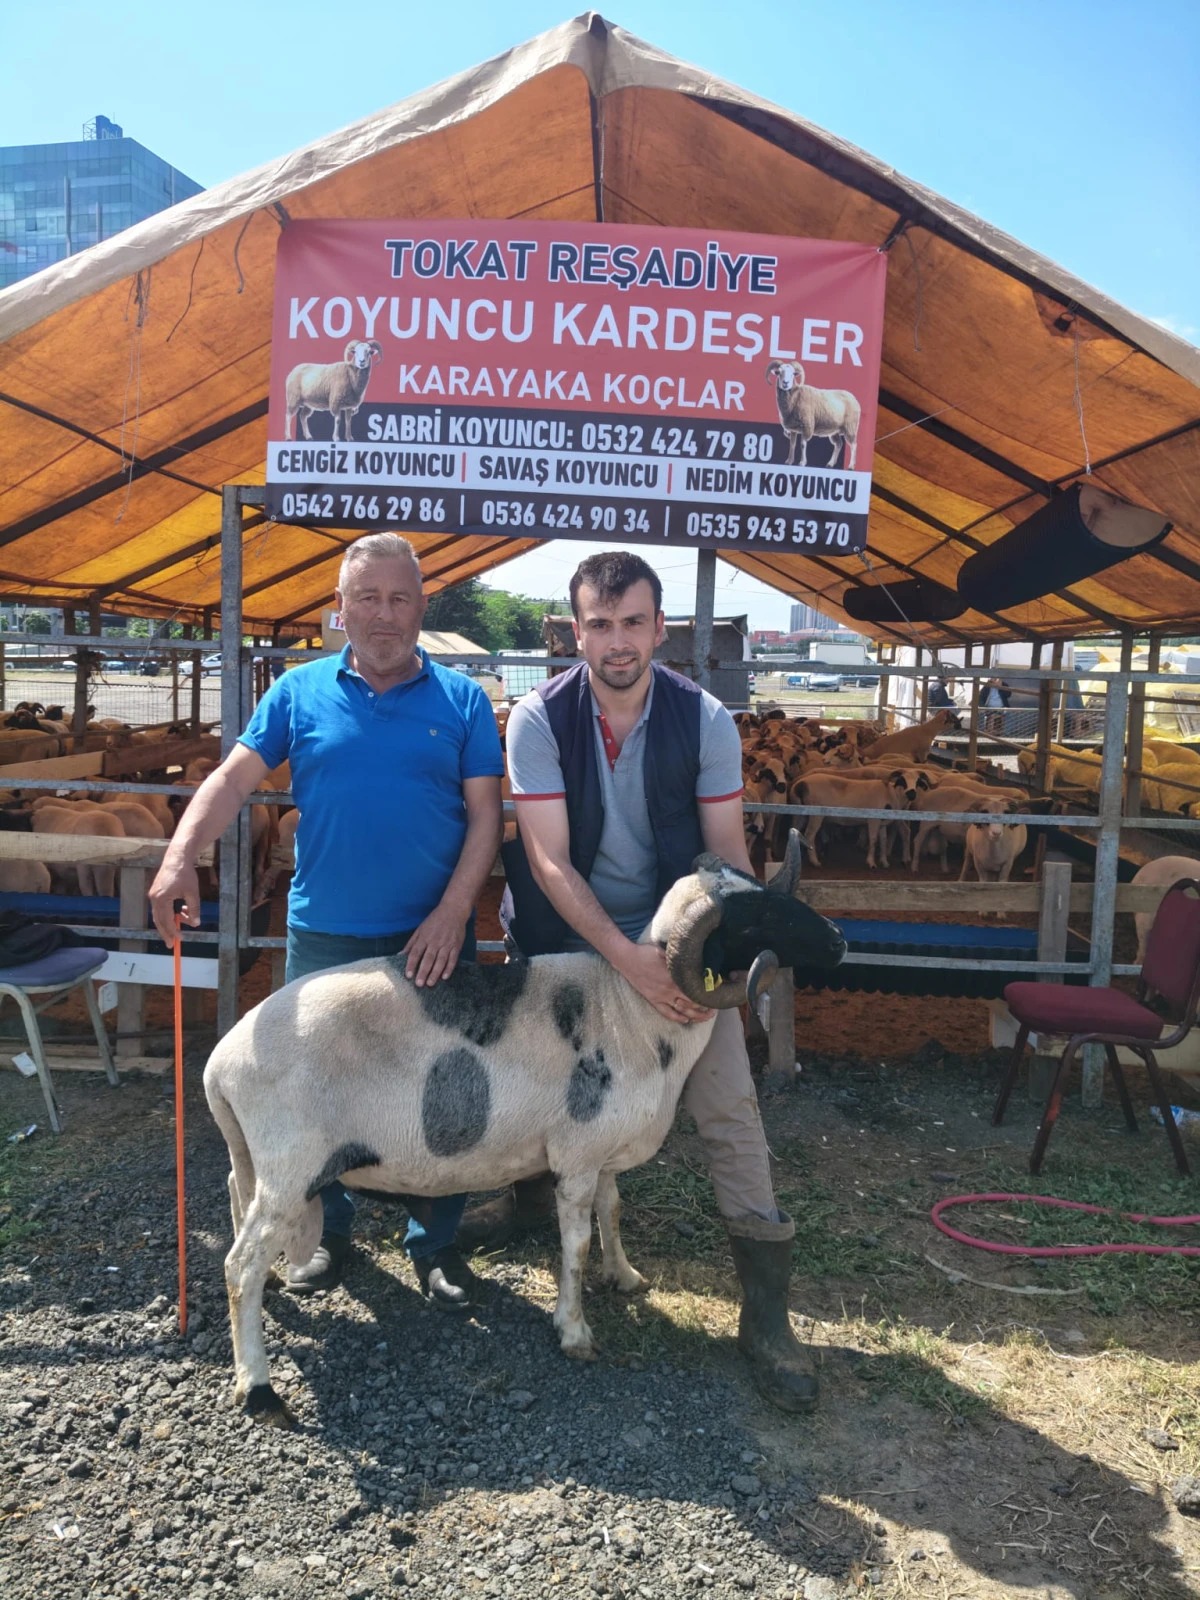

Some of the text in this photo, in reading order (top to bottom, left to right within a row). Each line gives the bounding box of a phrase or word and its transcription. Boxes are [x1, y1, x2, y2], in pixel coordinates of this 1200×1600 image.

[384, 239, 778, 295] TOKAT REŞADİYE
[289, 296, 864, 367] KOYUNCU KARDEŞLER
[399, 364, 746, 411] KARAYAKA KOÇLAR
[367, 408, 774, 462] SABRİ KOYUNCU: 0532 424 79 80
[277, 444, 455, 478] CENGİZ KOYUNCU
[479, 455, 659, 488] SAVAŞ KOYUNCU
[685, 463, 857, 503] NEDİM KOYUNCU
[282, 493, 446, 523] 0542 766 29 86
[482, 500, 650, 534] 0536 424 90 34
[686, 512, 850, 547] 0535 943 53 70
